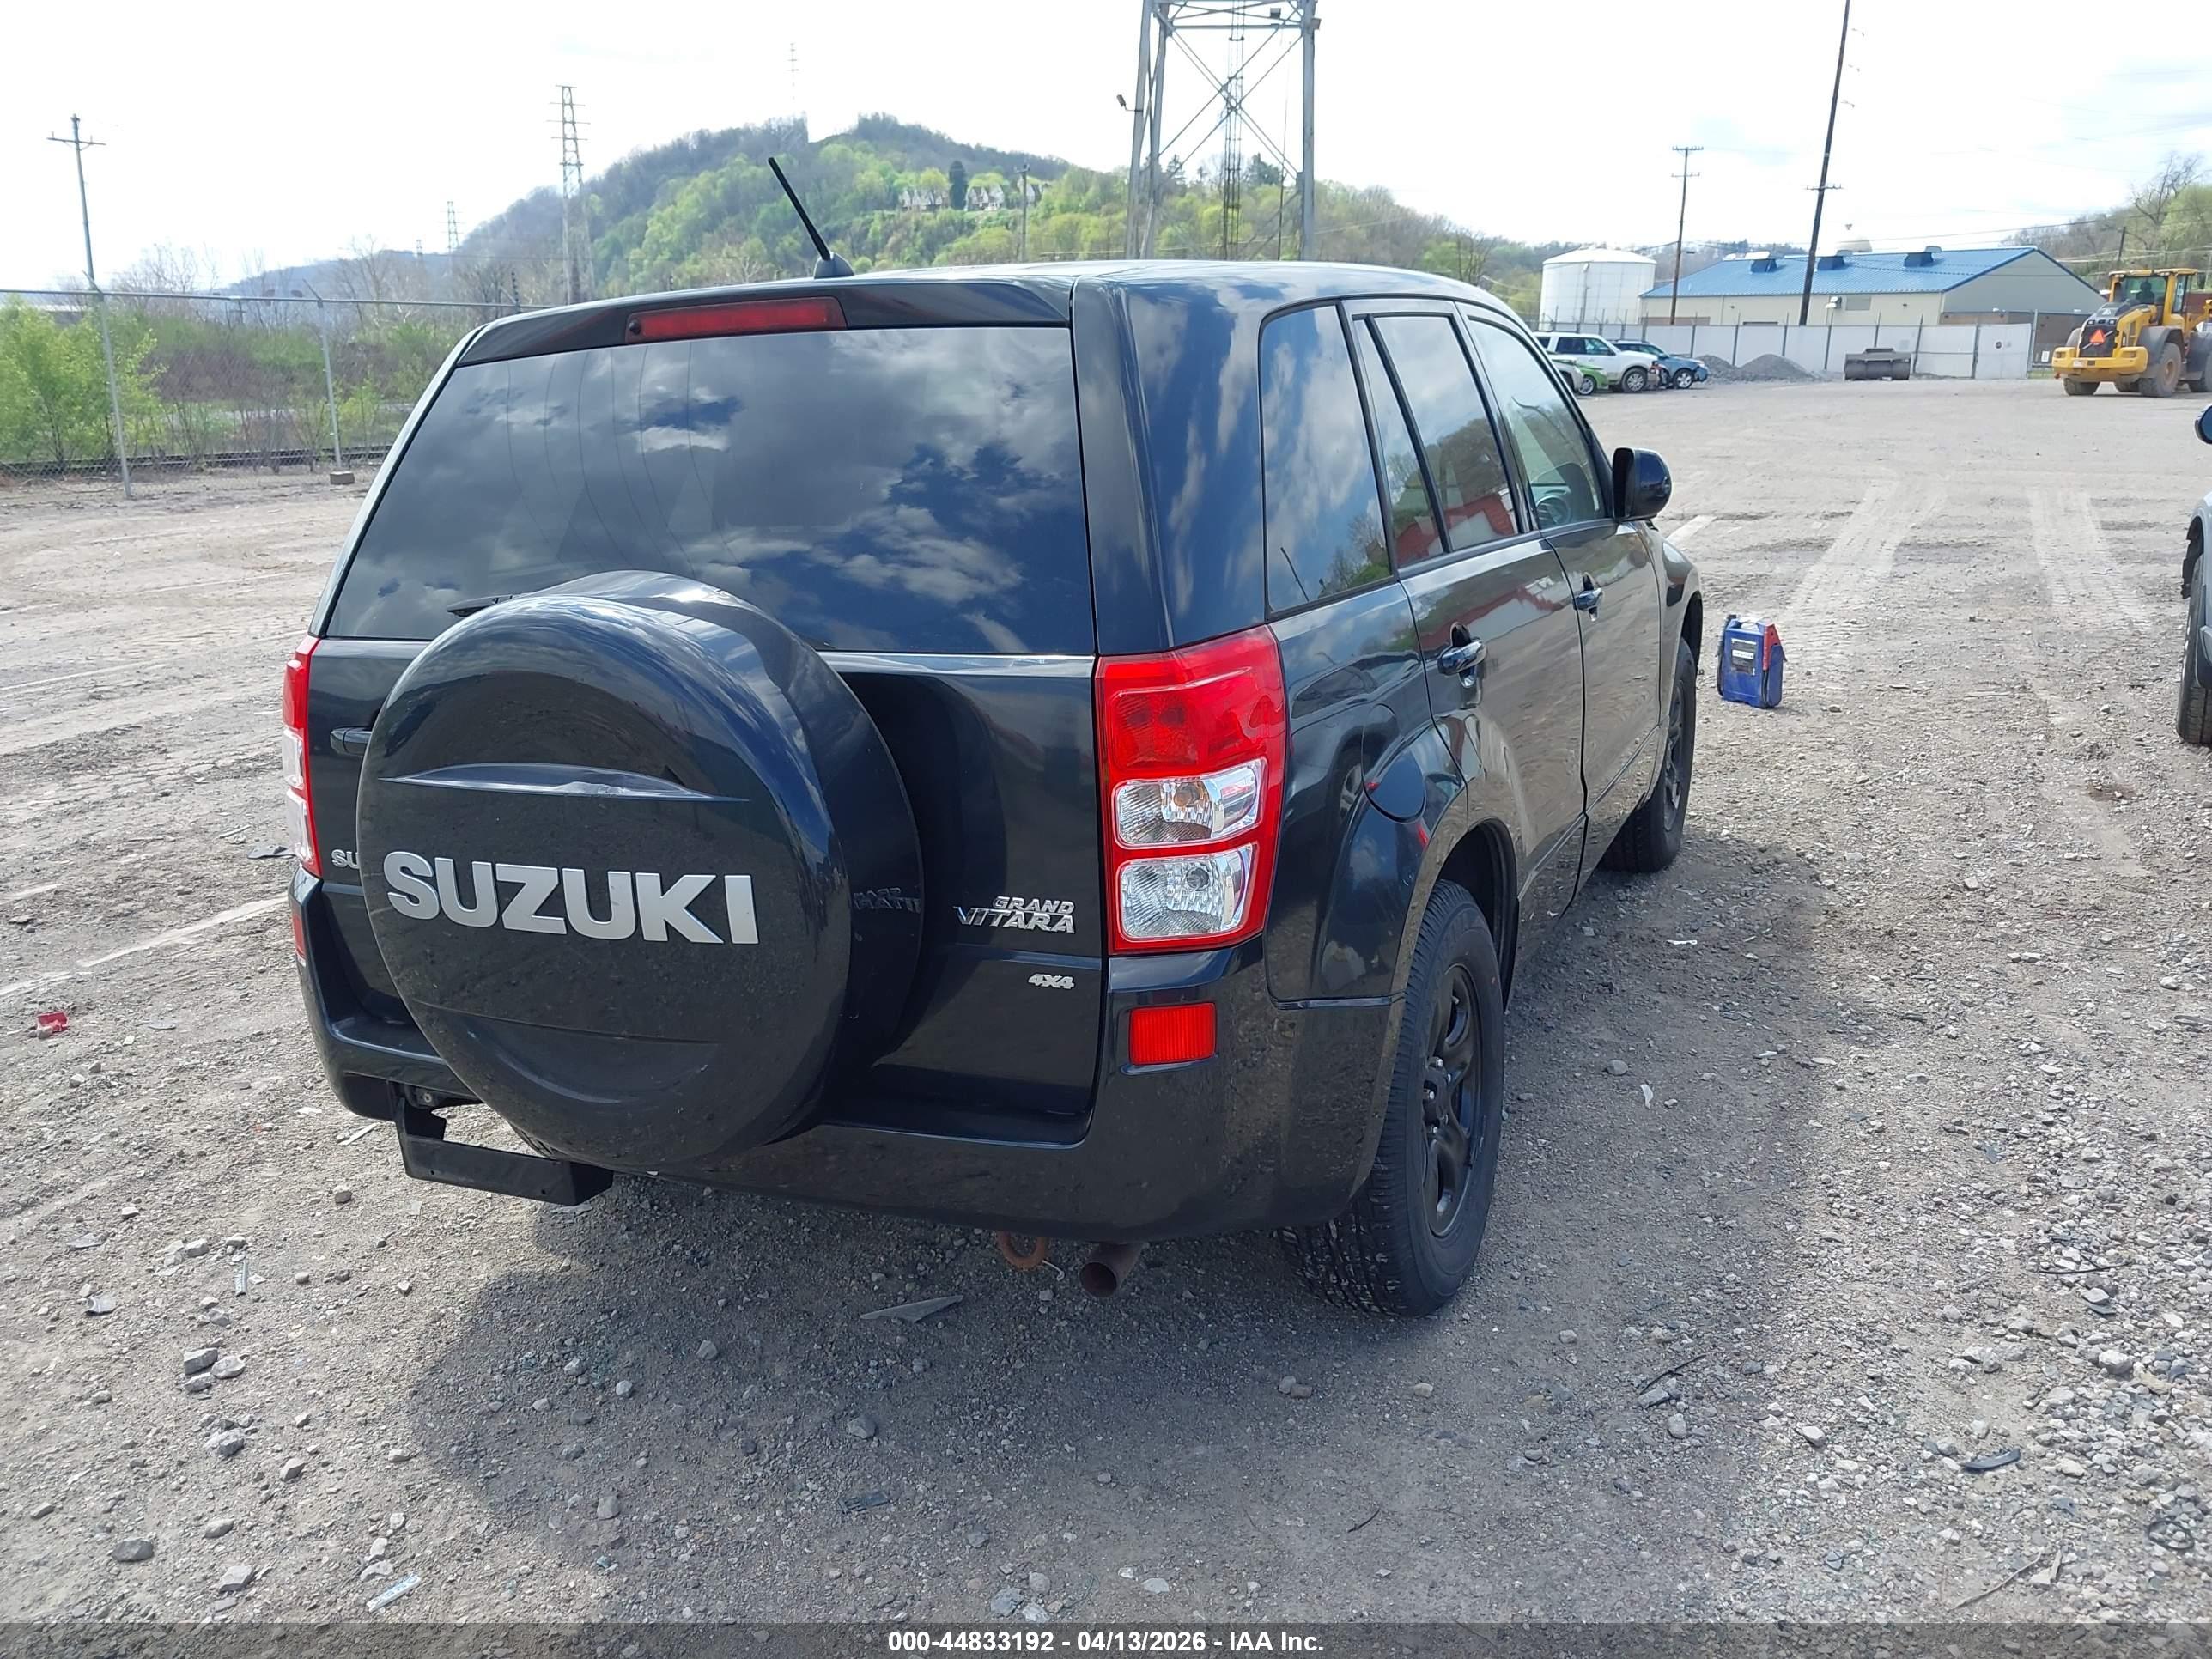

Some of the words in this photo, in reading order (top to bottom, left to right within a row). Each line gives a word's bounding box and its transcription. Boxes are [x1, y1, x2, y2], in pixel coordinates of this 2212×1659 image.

[383, 851, 759, 945] SUZUKI
[993, 896, 1075, 915] GRAND
[955, 907, 1075, 933] VITARA
